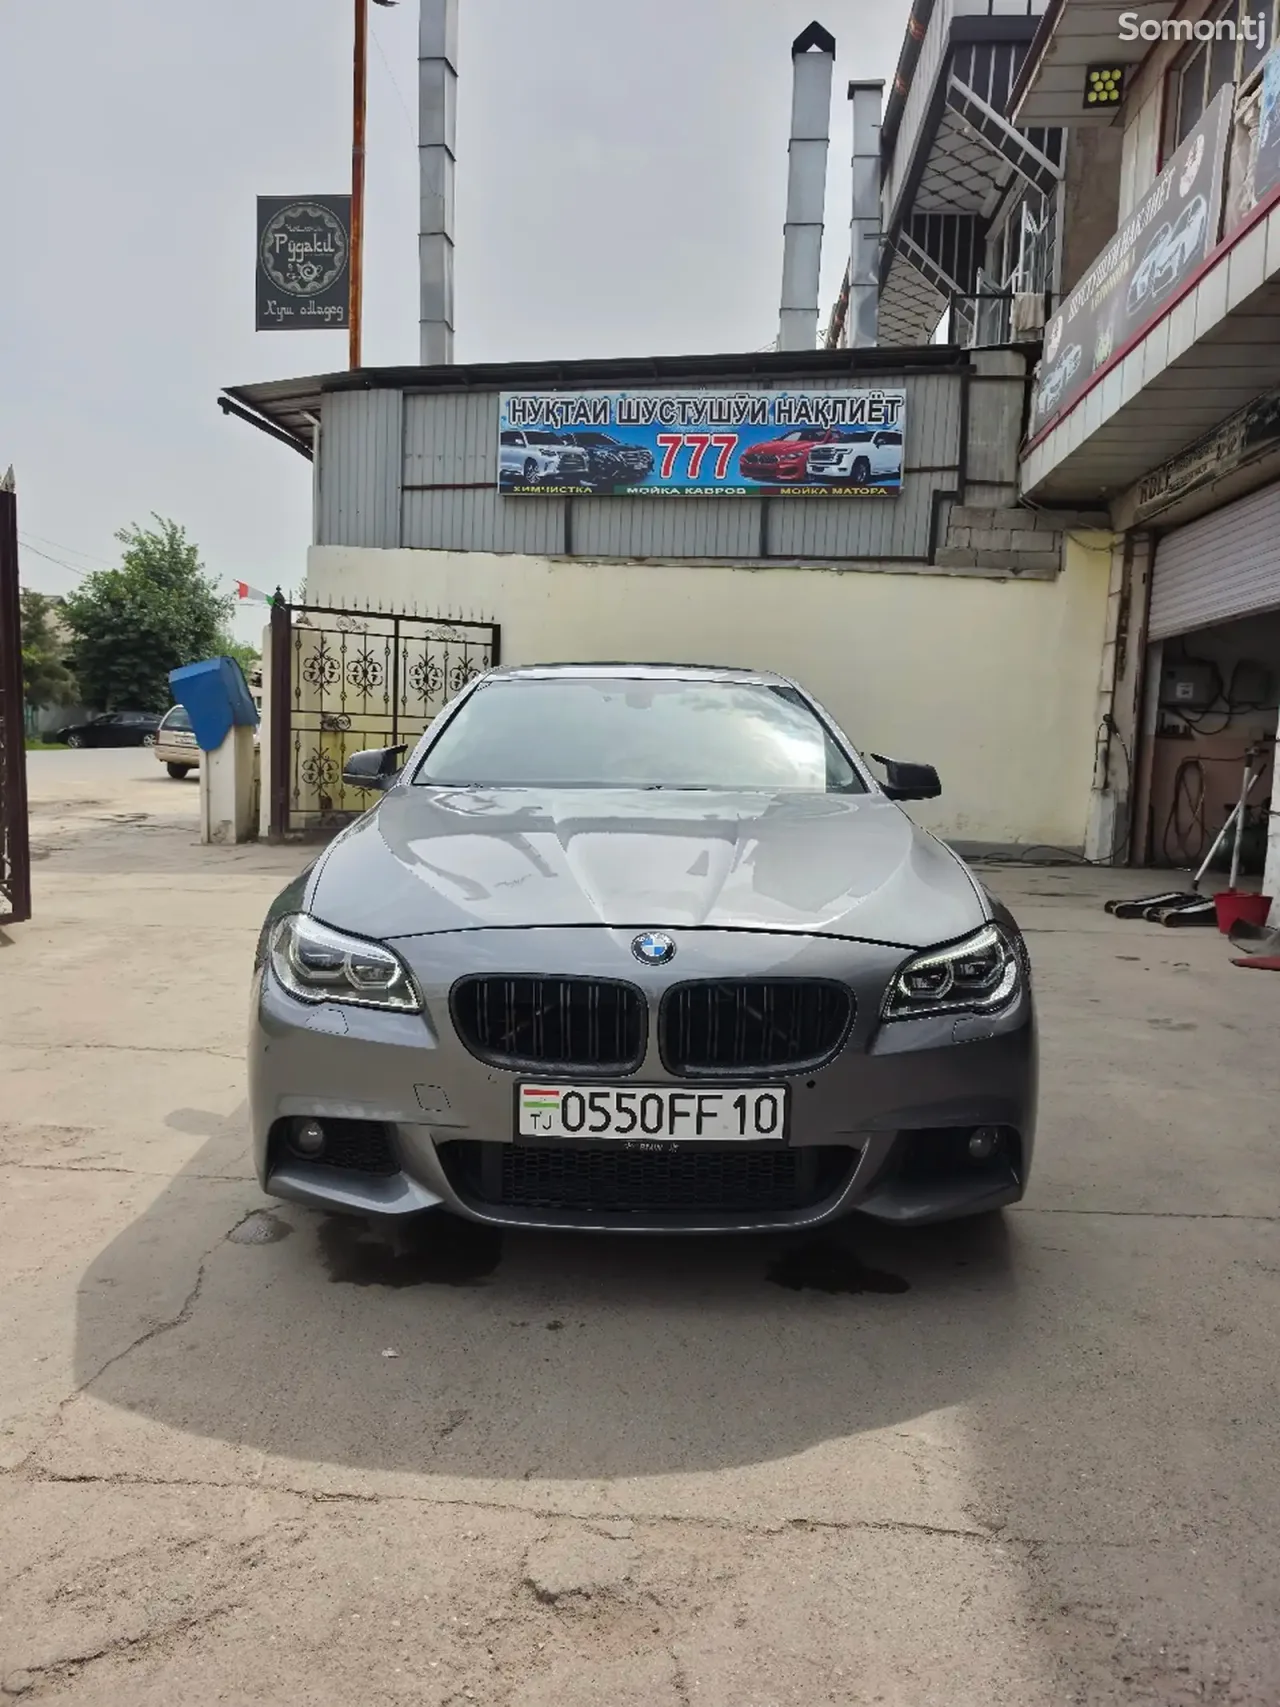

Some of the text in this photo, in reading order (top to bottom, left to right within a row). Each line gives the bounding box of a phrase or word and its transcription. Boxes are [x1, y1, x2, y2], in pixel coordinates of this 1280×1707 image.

[510, 391, 904, 429] НУҚТАИ ШУСТУШӮИ НАҚЛИЁТ
[657, 433, 738, 479] 777
[513, 485, 593, 494] ХИМЧИСТКА
[626, 485, 681, 495] МОЙКА
[780, 485, 888, 495] МОЙКА МАТОРА
[561, 1090, 778, 1135] 0550FF 10
[530, 1113, 552, 1131] TJ
